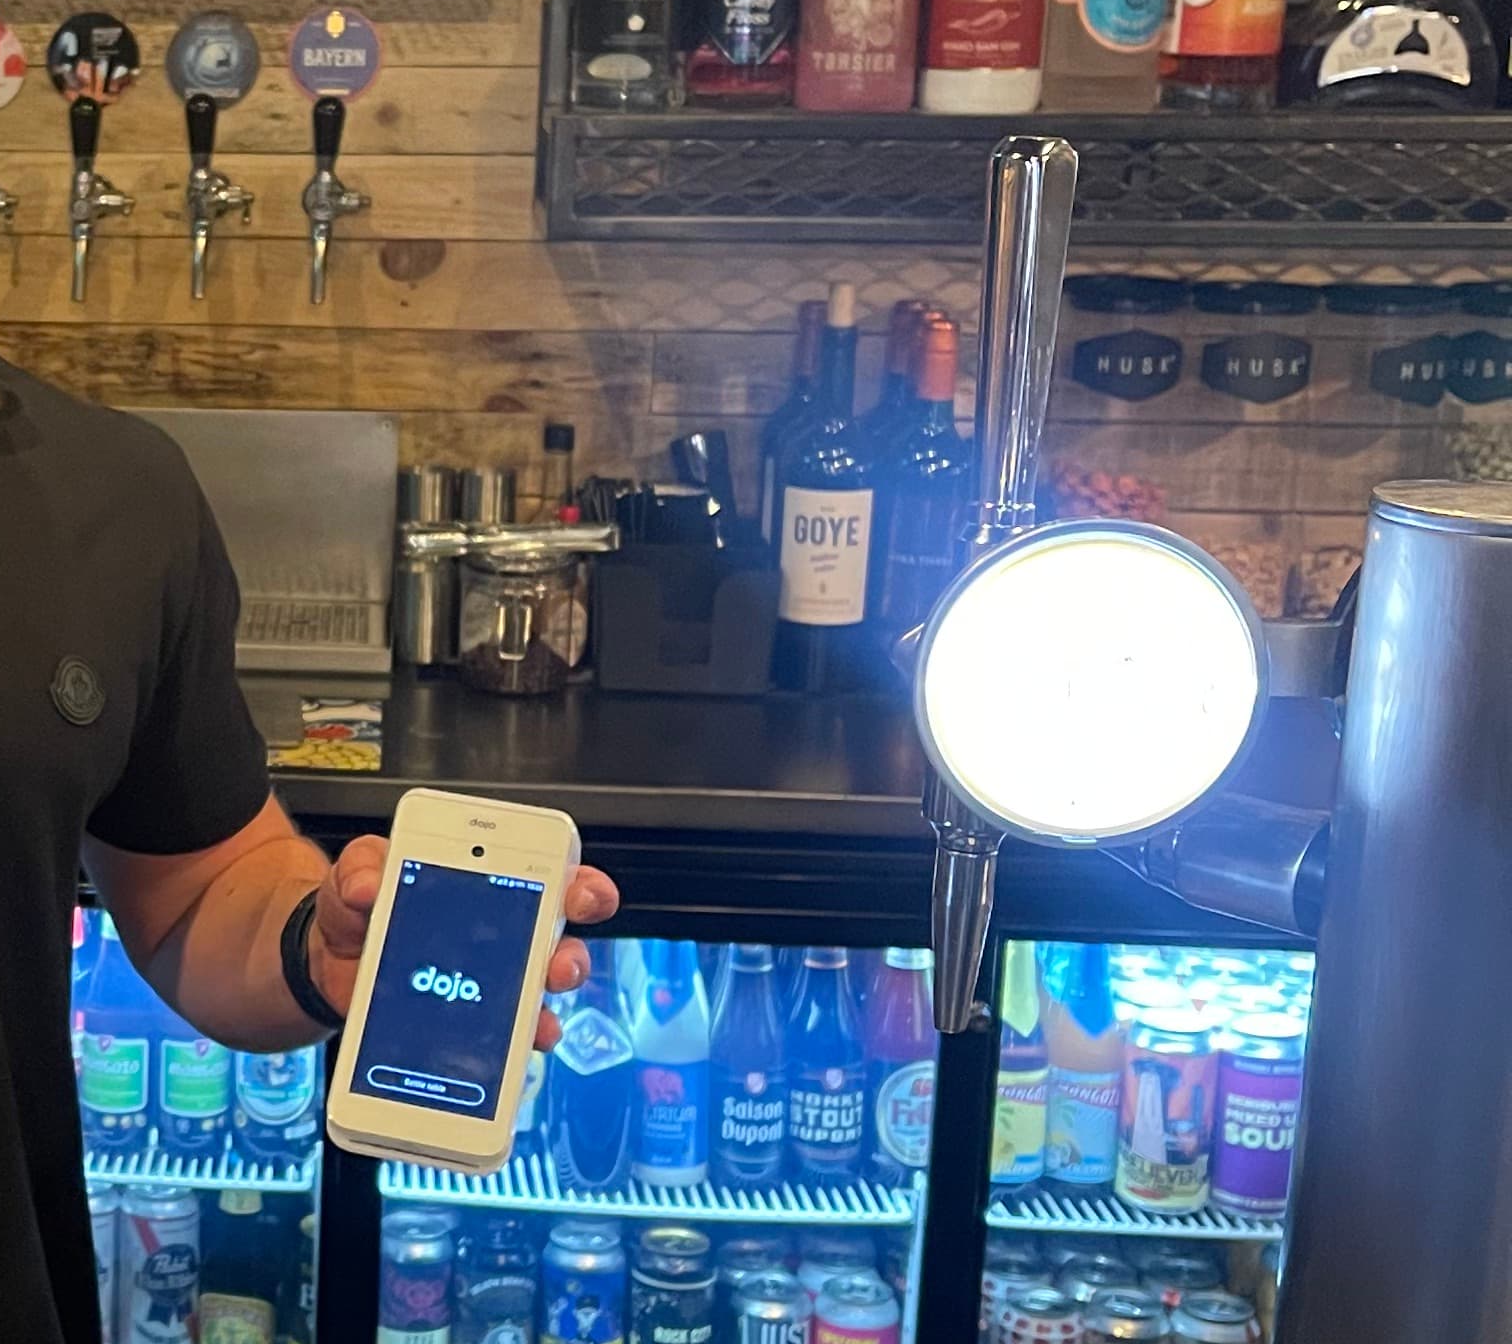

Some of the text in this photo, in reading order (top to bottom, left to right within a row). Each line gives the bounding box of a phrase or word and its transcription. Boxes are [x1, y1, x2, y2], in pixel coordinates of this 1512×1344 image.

[303, 48, 367, 67] BAYERN
[794, 515, 860, 547] GOYE
[469, 818, 496, 830] dojo
[412, 966, 482, 1003] dojo.
[723, 1096, 784, 1119] Saison
[722, 1119, 784, 1146] Dupont
